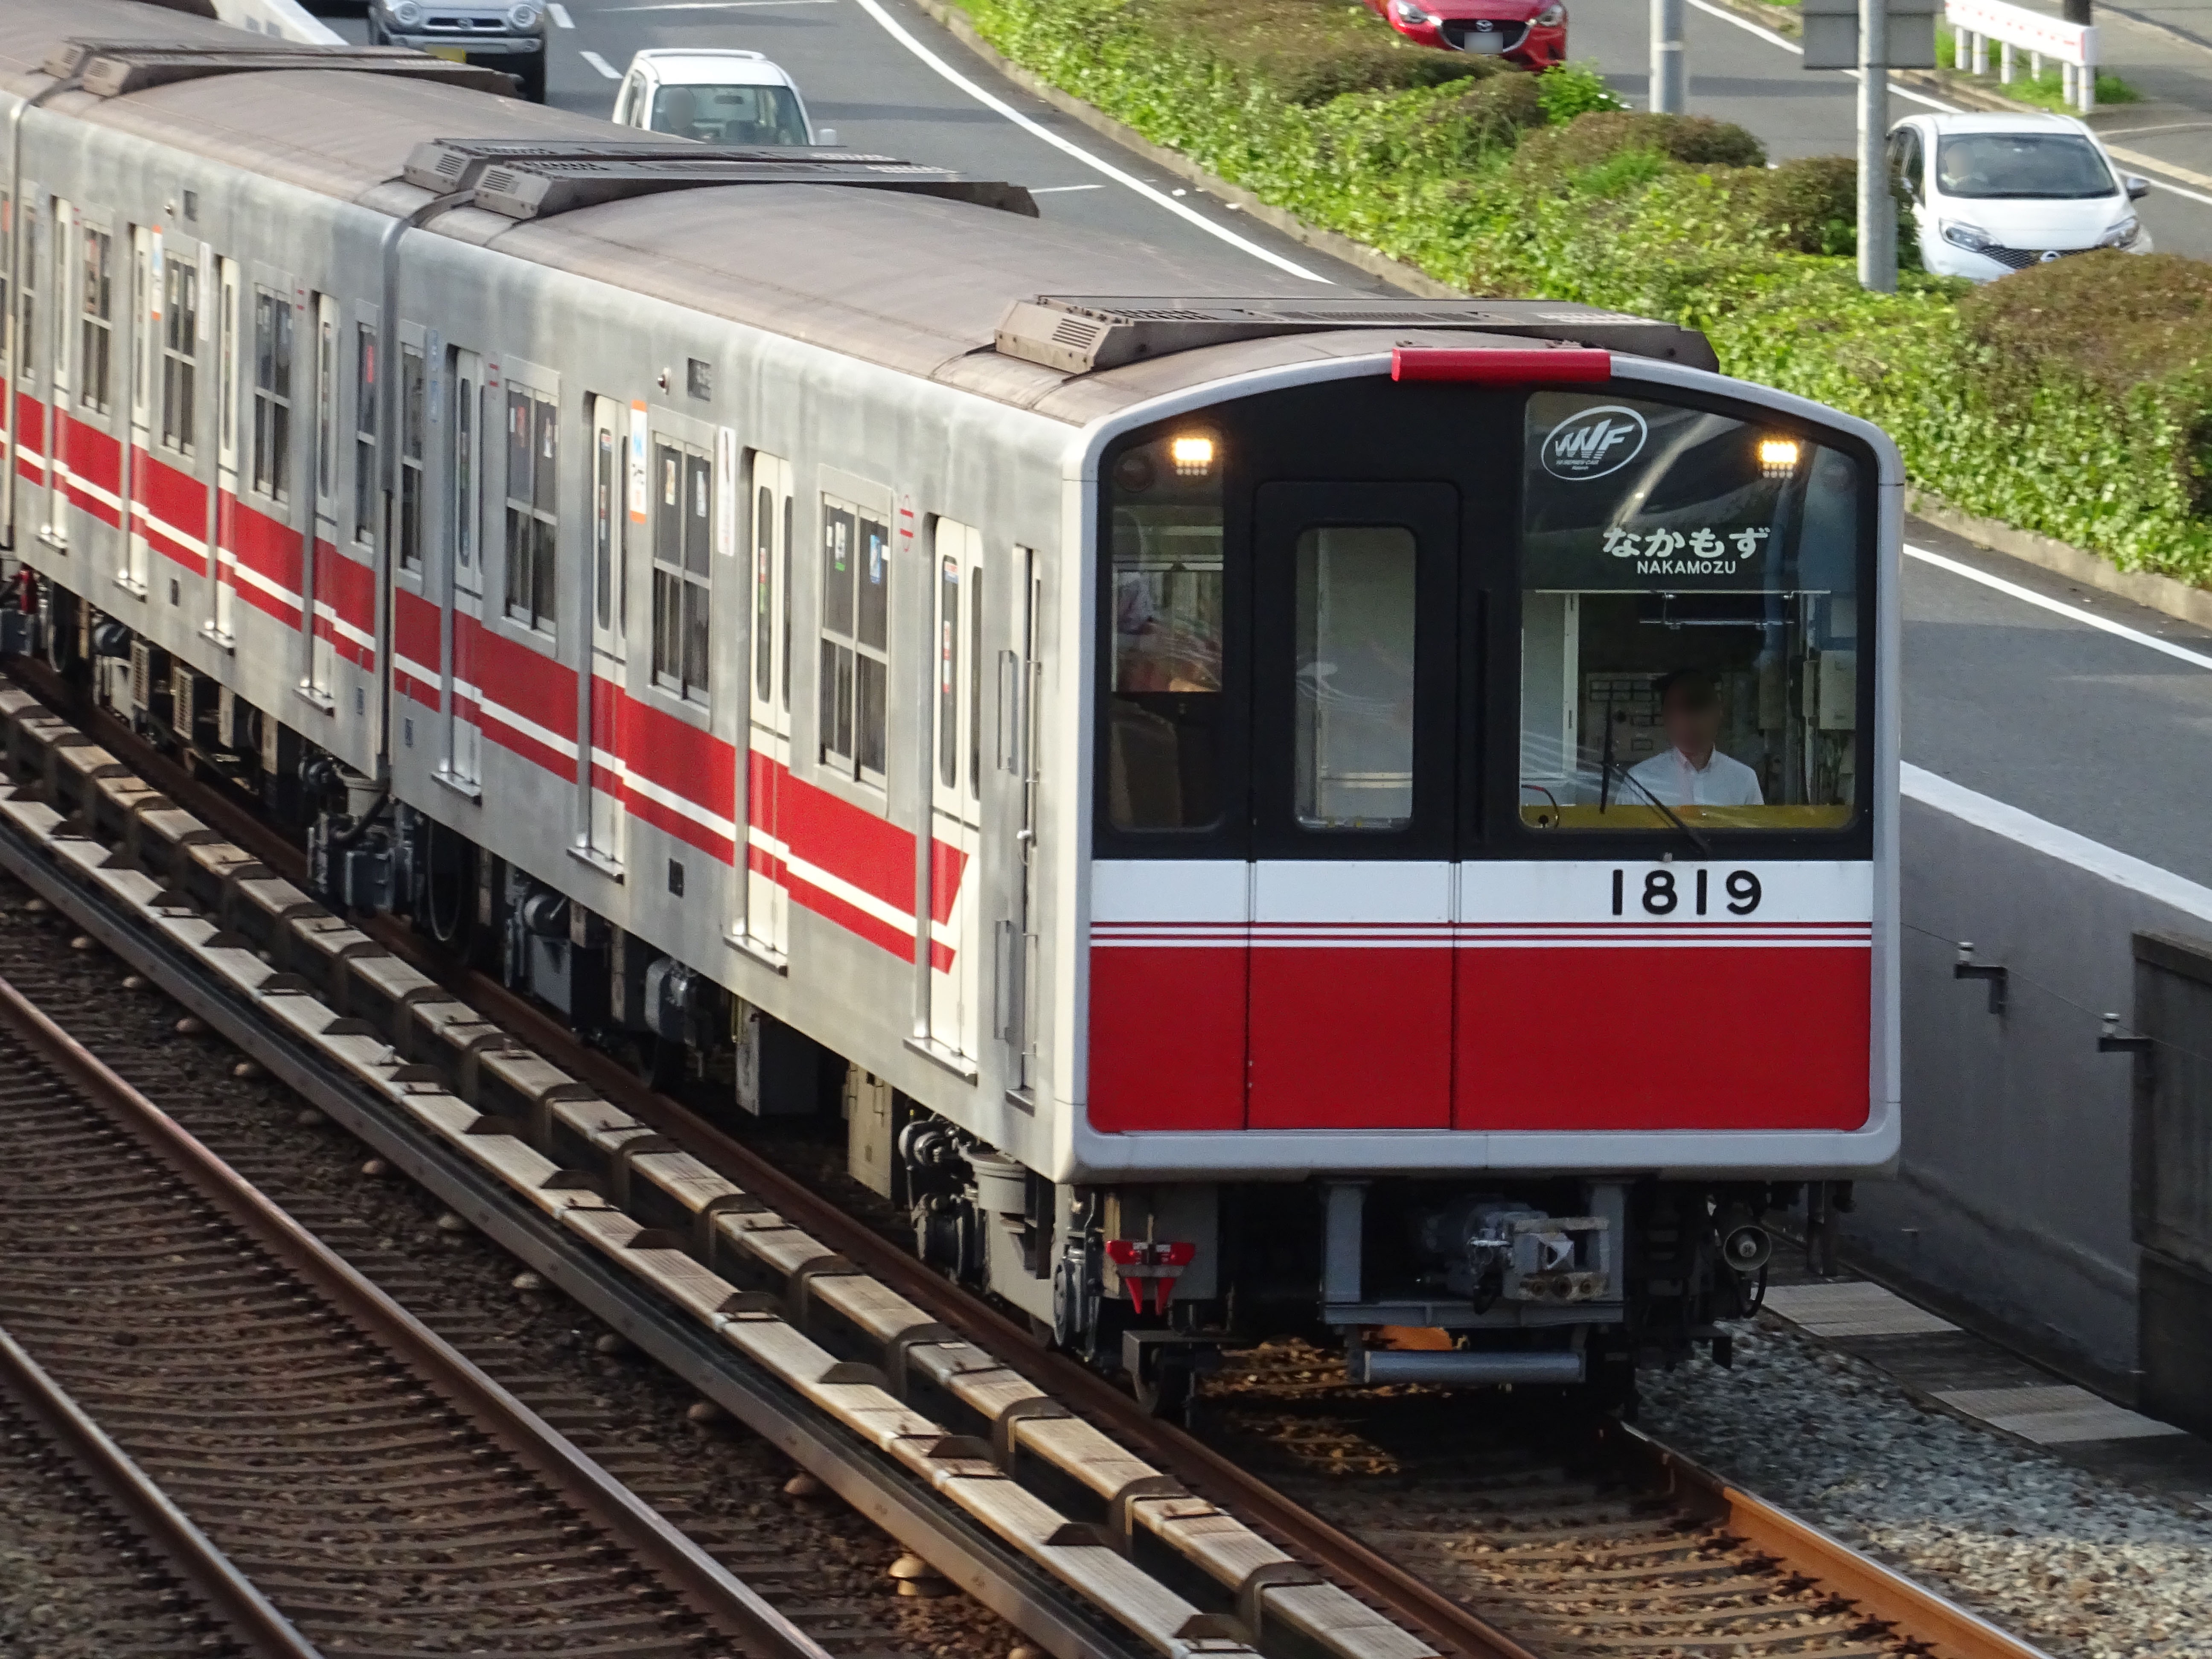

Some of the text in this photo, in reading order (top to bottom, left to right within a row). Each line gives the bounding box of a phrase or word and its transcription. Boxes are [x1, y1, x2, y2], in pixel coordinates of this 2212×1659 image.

[1603, 527, 1770, 559] なかもず
[1637, 560, 1736, 574] NAKAMOZU
[1612, 869, 1762, 915] 1819
